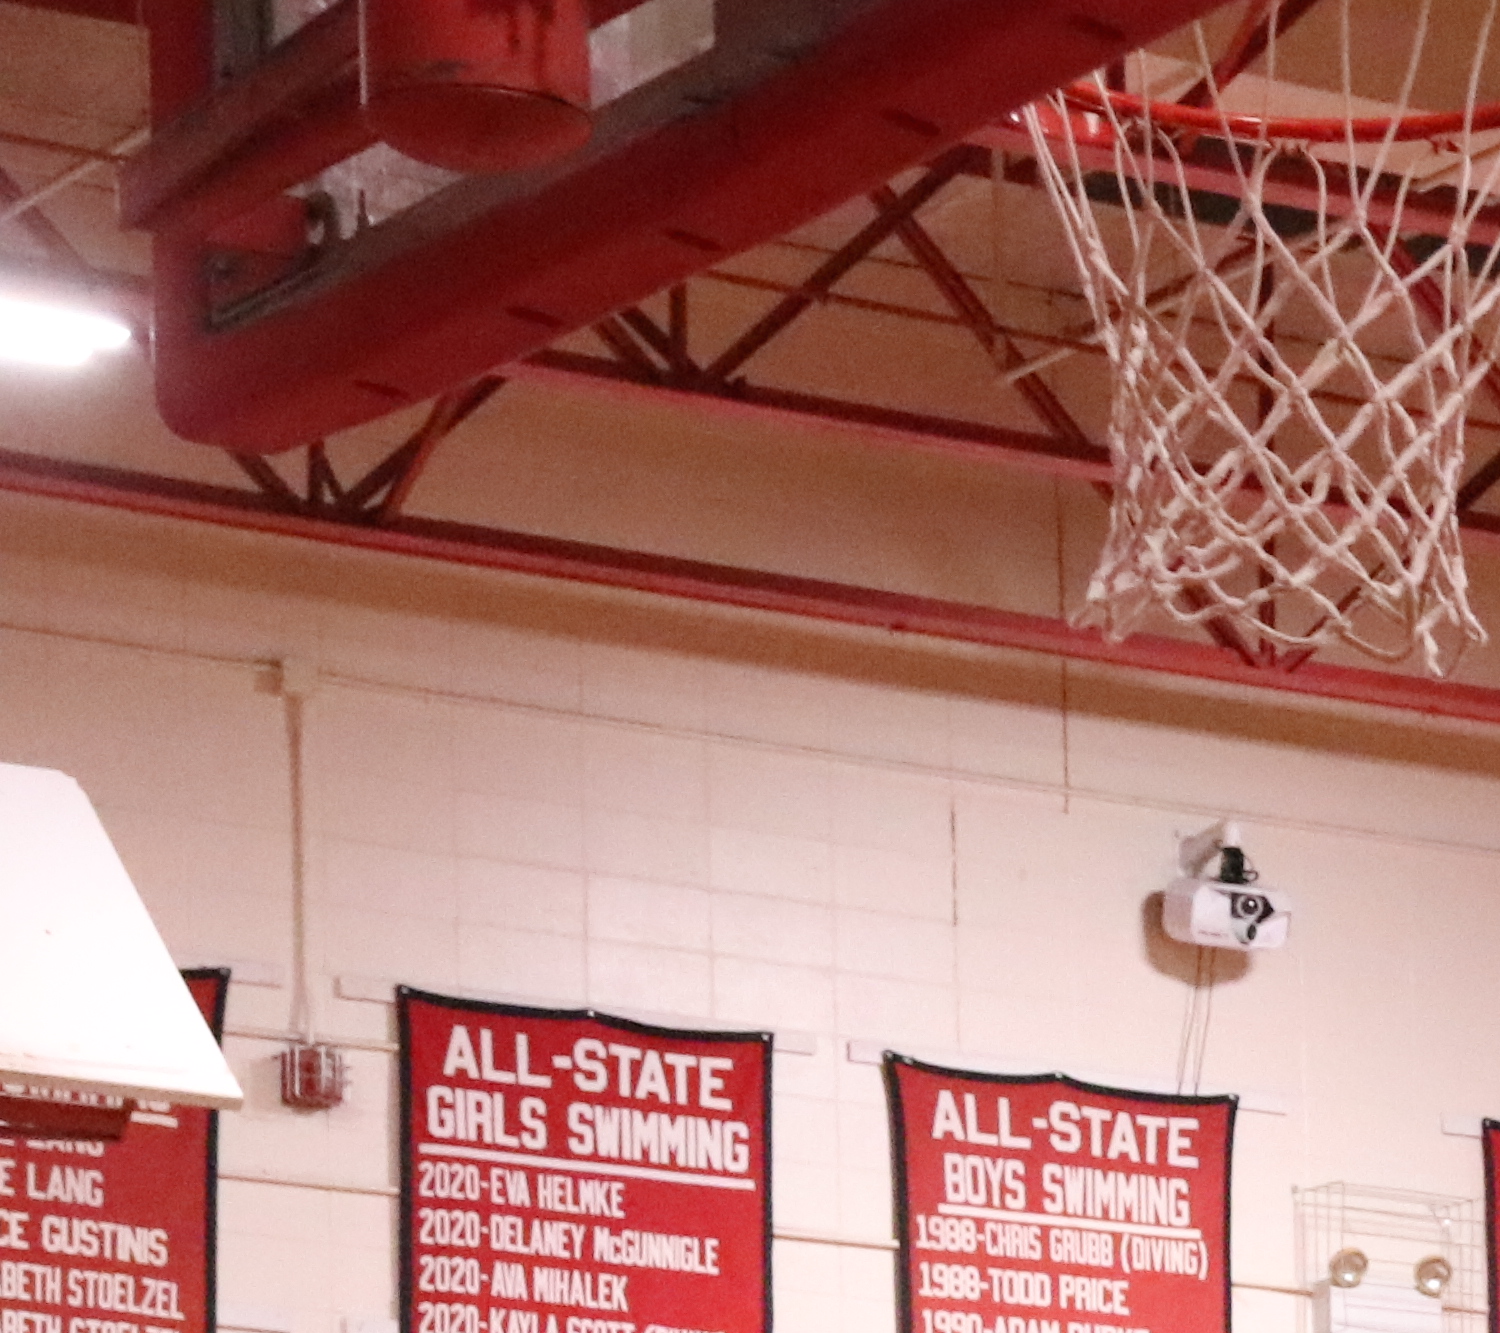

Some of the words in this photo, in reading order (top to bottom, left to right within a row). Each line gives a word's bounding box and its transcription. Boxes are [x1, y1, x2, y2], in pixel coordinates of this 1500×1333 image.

[444, 1026, 733, 1111] ALL-STATE
[428, 1087, 546, 1149] GIRLS
[568, 1103, 749, 1173] SWIMMING
[933, 1090, 1199, 1168] ALL-STATE
[27, 1163, 103, 1207] LANG
[420, 1162, 530, 1207] 2020-EVA
[538, 1174, 625, 1217] HELMKE
[939, 1154, 1025, 1212] BOYS
[1043, 1165, 1190, 1228] SWIMMING
[42, 1216, 167, 1266] GUSTINIS
[420, 1209, 585, 1259] 2020-DELANEY
[917, 1215, 1041, 1260] 1988-CHRIS
[1050, 1228, 1113, 1267] GRUBB
[1121, 1233, 1207, 1280] (DIVING)
[68, 1269, 184, 1320] STOELZEL
[420, 1257, 527, 1300] 2020-AVA
[533, 1267, 628, 1311] MIHALEK
[919, 1263, 1051, 1307] 1988-TODD
[1060, 1276, 1129, 1315] PRICE
